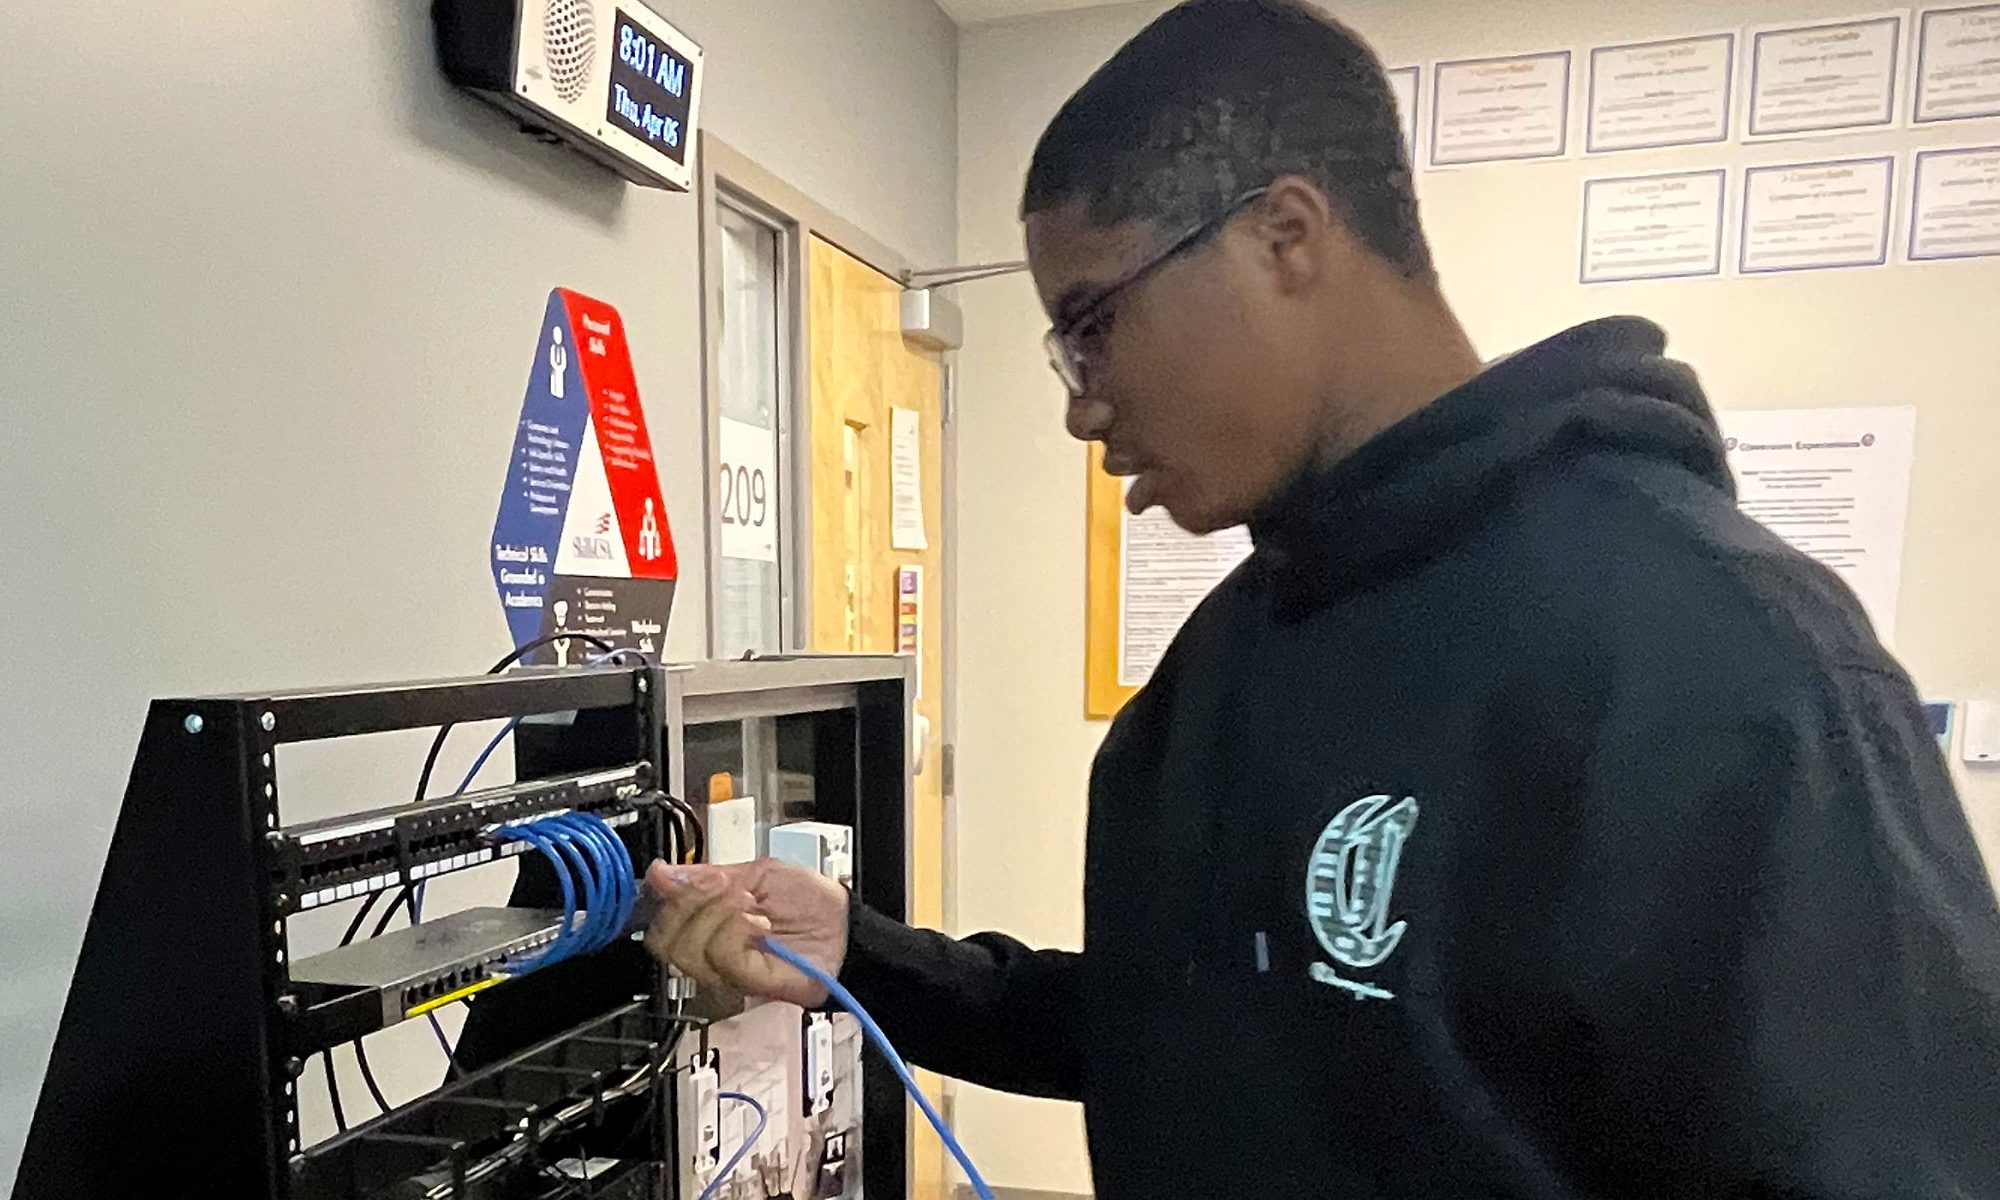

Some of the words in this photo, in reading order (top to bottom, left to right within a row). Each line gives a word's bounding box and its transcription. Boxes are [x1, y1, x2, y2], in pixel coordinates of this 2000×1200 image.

[620, 24, 655, 78] 8:01
[656, 52, 684, 97] AM
[614, 83, 639, 127] Thu,
[642, 103, 663, 138] Apr
[663, 116, 679, 147] 05
[720, 463, 766, 527] 209
